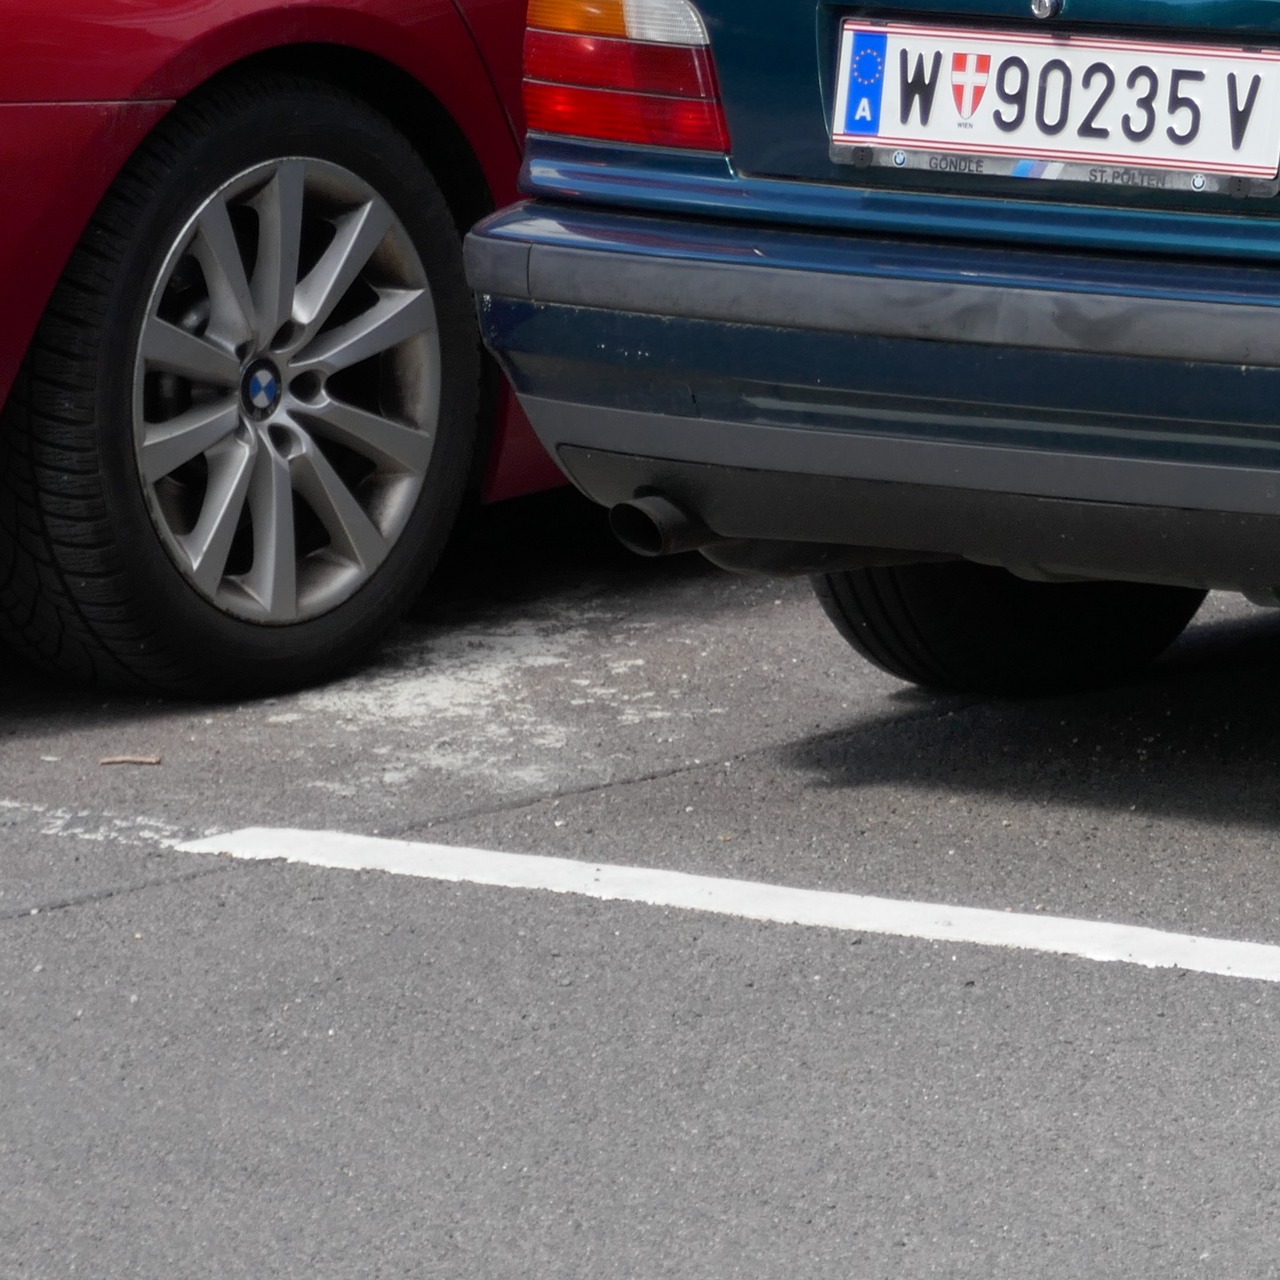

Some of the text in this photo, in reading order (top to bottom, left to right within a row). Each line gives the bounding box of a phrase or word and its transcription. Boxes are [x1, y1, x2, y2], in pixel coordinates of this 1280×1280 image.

[854, 98, 872, 121] A
[899, 48, 1262, 151] W 90235 V
